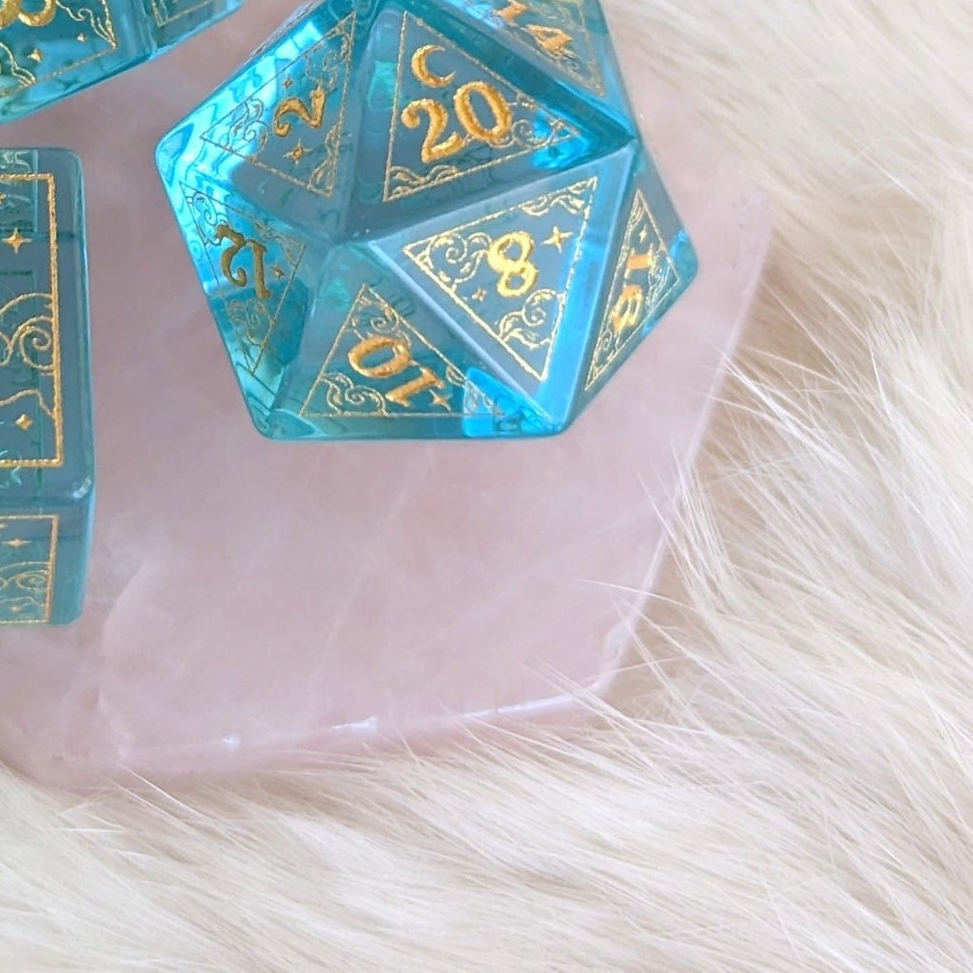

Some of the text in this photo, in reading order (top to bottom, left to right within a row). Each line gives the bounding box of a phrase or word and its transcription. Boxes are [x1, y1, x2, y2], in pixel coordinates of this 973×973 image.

[273, 86, 325, 136] 2
[401, 80, 513, 163] 20
[215, 224, 271, 299] 12
[487, 231, 539, 298] 8
[347, 336, 445, 405] 10
